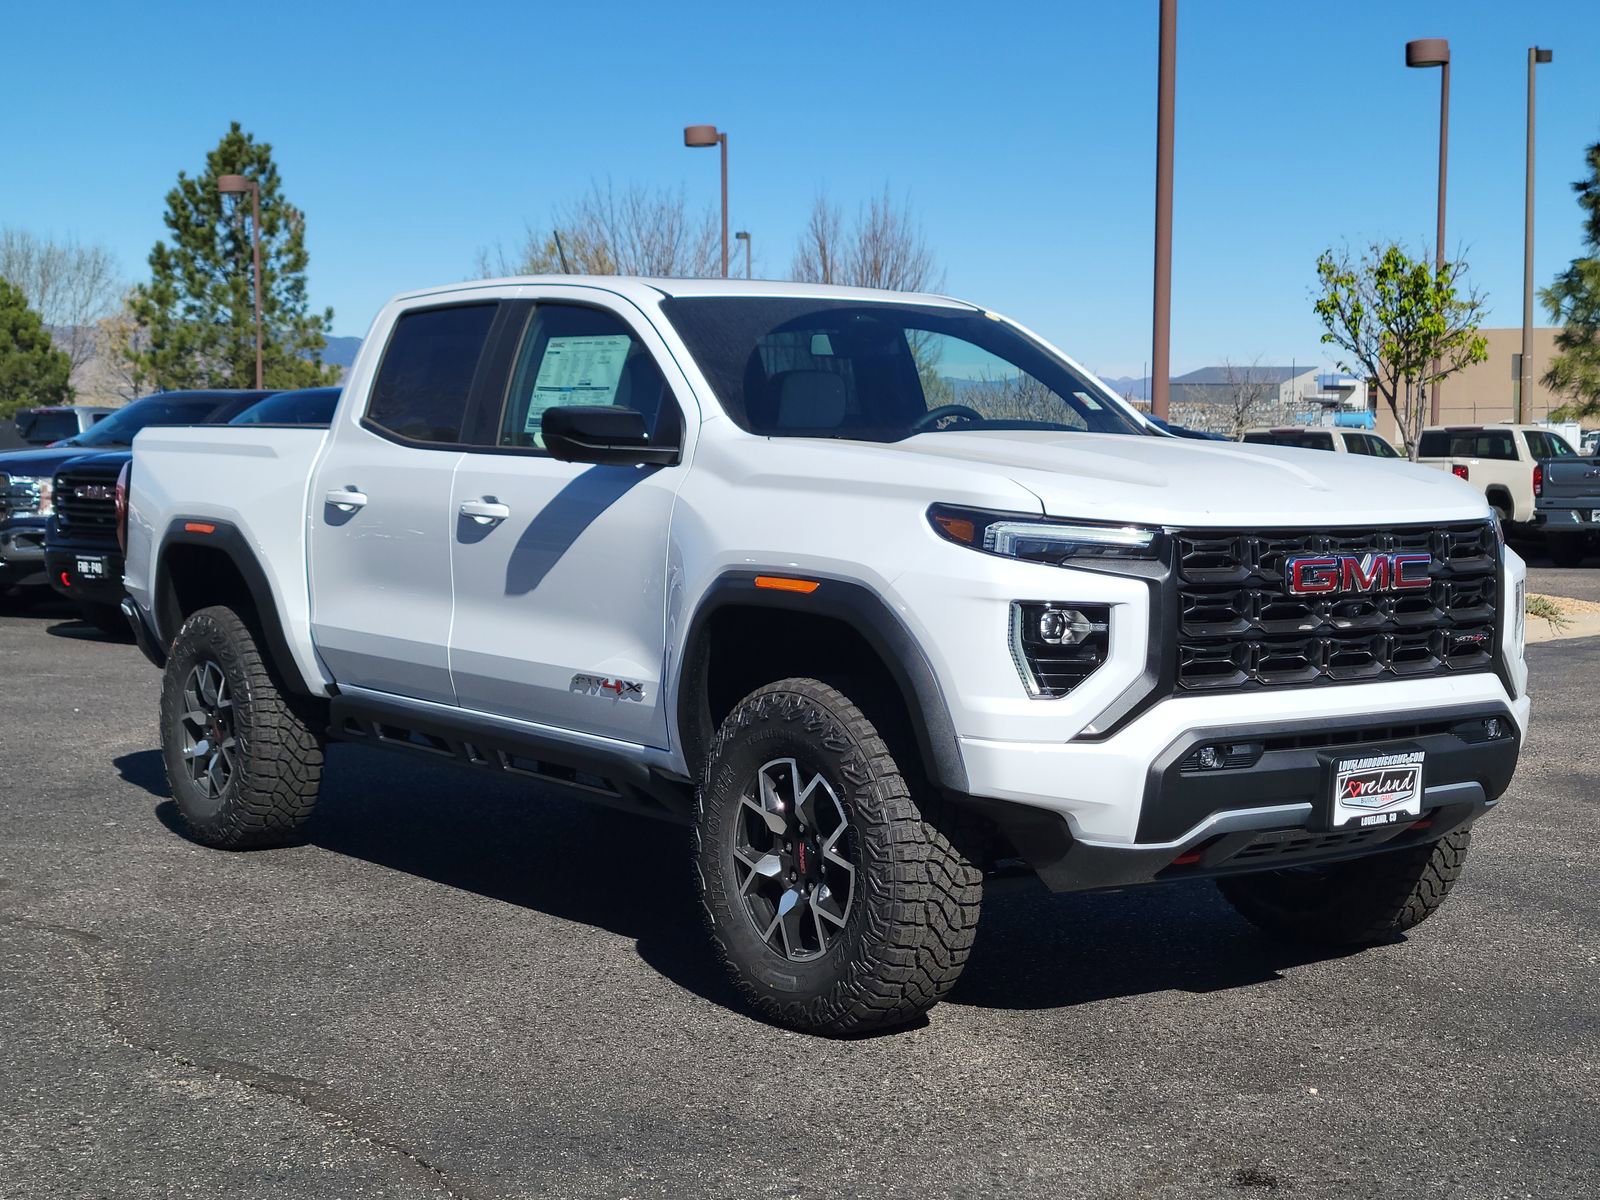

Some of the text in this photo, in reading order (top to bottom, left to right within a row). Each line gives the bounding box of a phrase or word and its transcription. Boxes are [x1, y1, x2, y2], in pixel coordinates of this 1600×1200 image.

[1287, 553, 1432, 595] GMC
[568, 673, 646, 703] AT4X
[799, 840, 807, 875] GMC
